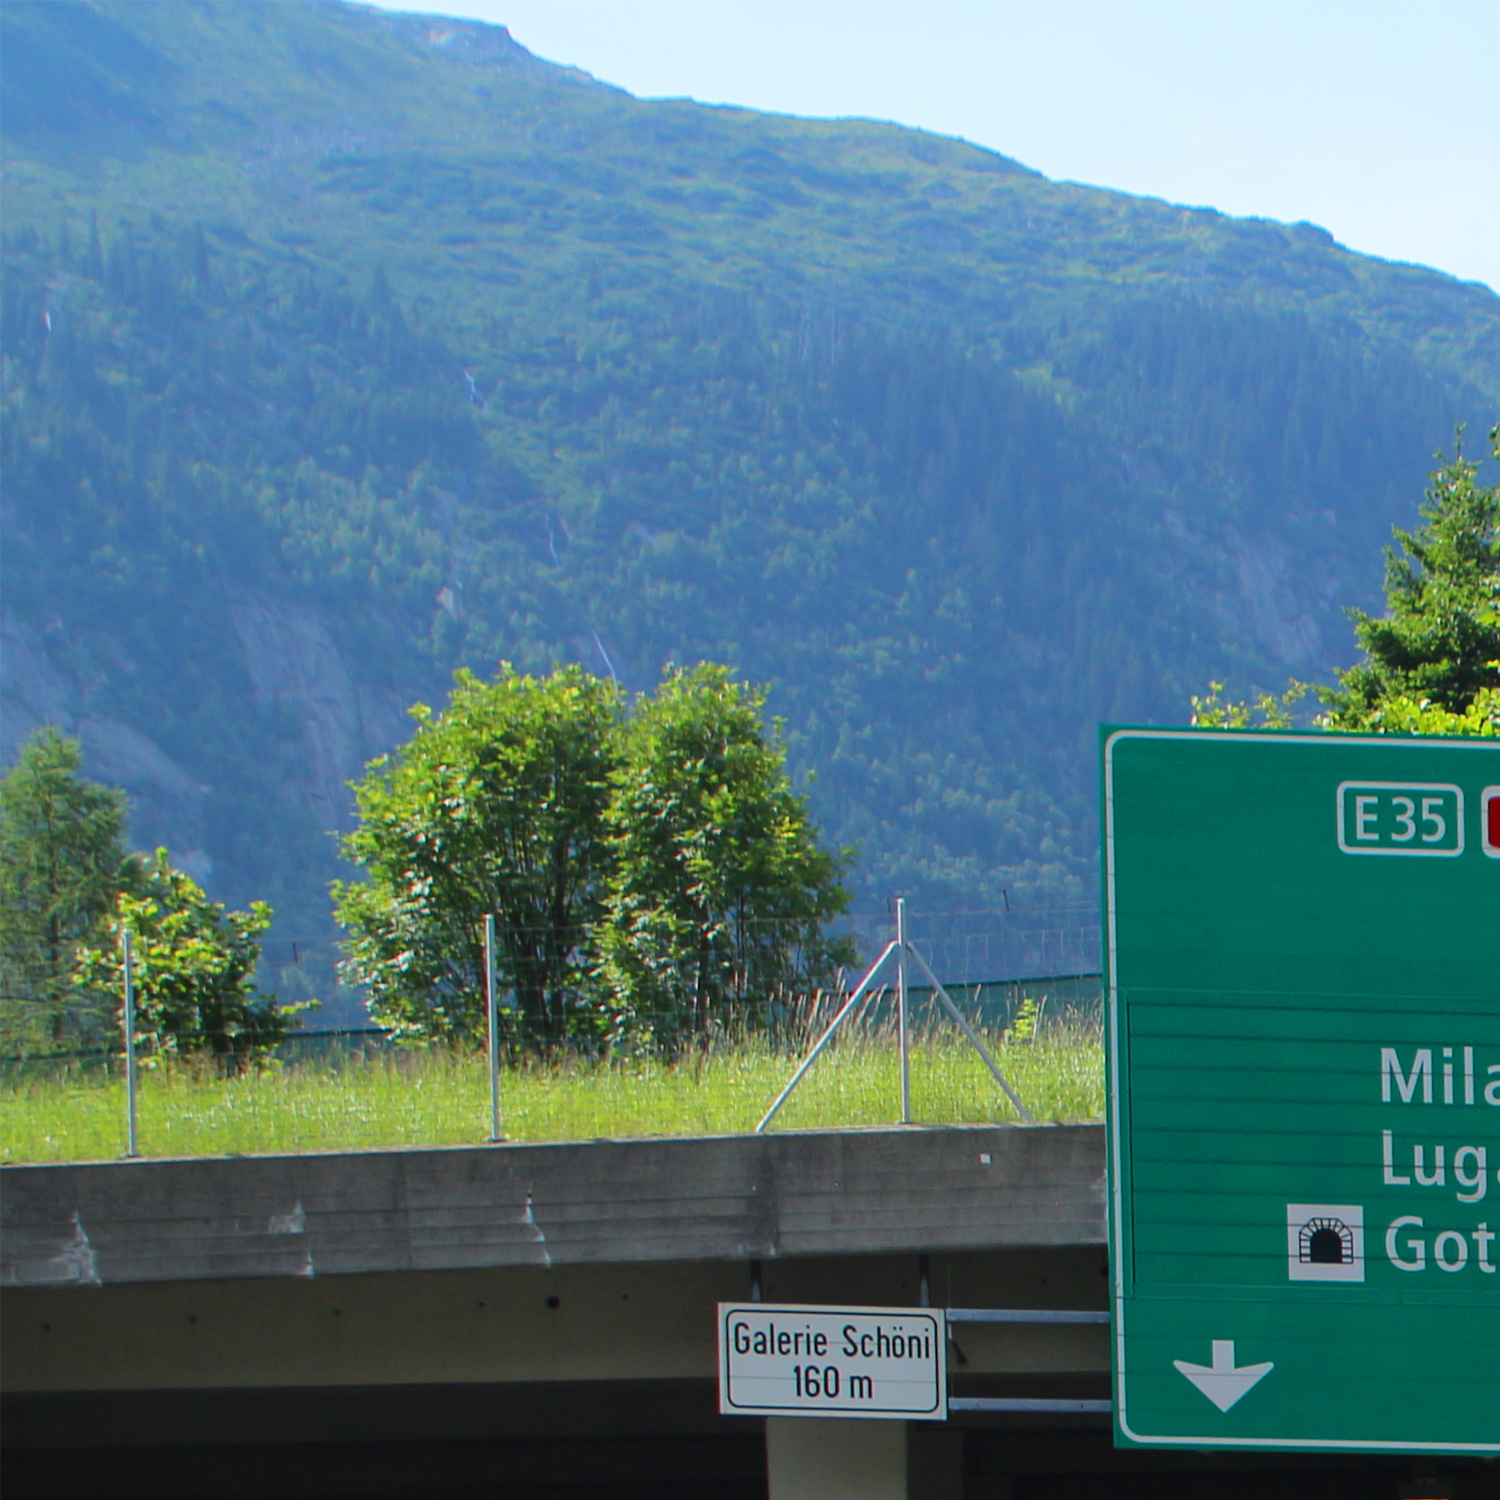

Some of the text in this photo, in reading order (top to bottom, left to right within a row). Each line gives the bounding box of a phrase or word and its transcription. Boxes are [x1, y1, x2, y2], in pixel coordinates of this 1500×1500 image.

[733, 1321, 931, 1360] Galerie Schöni
[793, 1364, 874, 1400] 160 m
